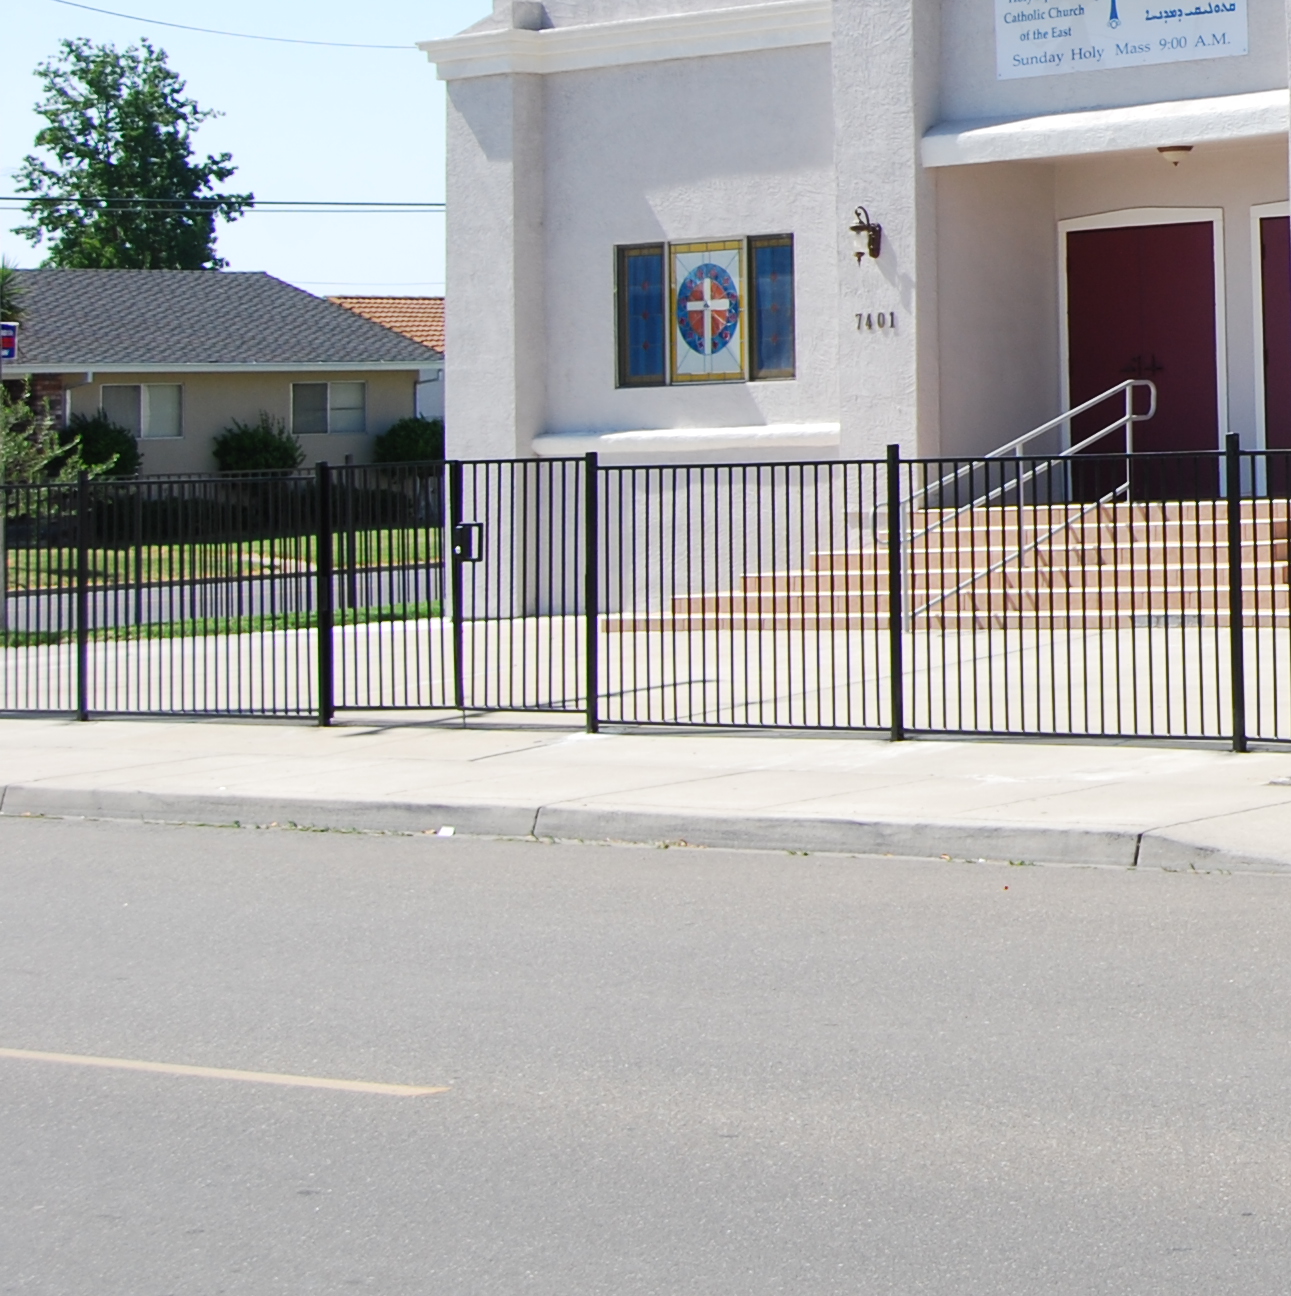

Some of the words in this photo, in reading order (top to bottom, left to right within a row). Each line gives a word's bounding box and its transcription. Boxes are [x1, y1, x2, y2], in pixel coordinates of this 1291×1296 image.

[1003, 8, 1046, 24] Catholic
[1048, 4, 1085, 18] Church
[1020, 29, 1031, 42] of
[1033, 27, 1049, 40] the
[1051, 26, 1072, 38] East
[1012, 51, 1065, 67] Sunday
[1071, 45, 1105, 62] Holy
[1114, 42, 1151, 56] Mass
[1158, 35, 1188, 50] 9:00
[1194, 32, 1231, 48] A.M.
[855, 310, 896, 331] 7401
